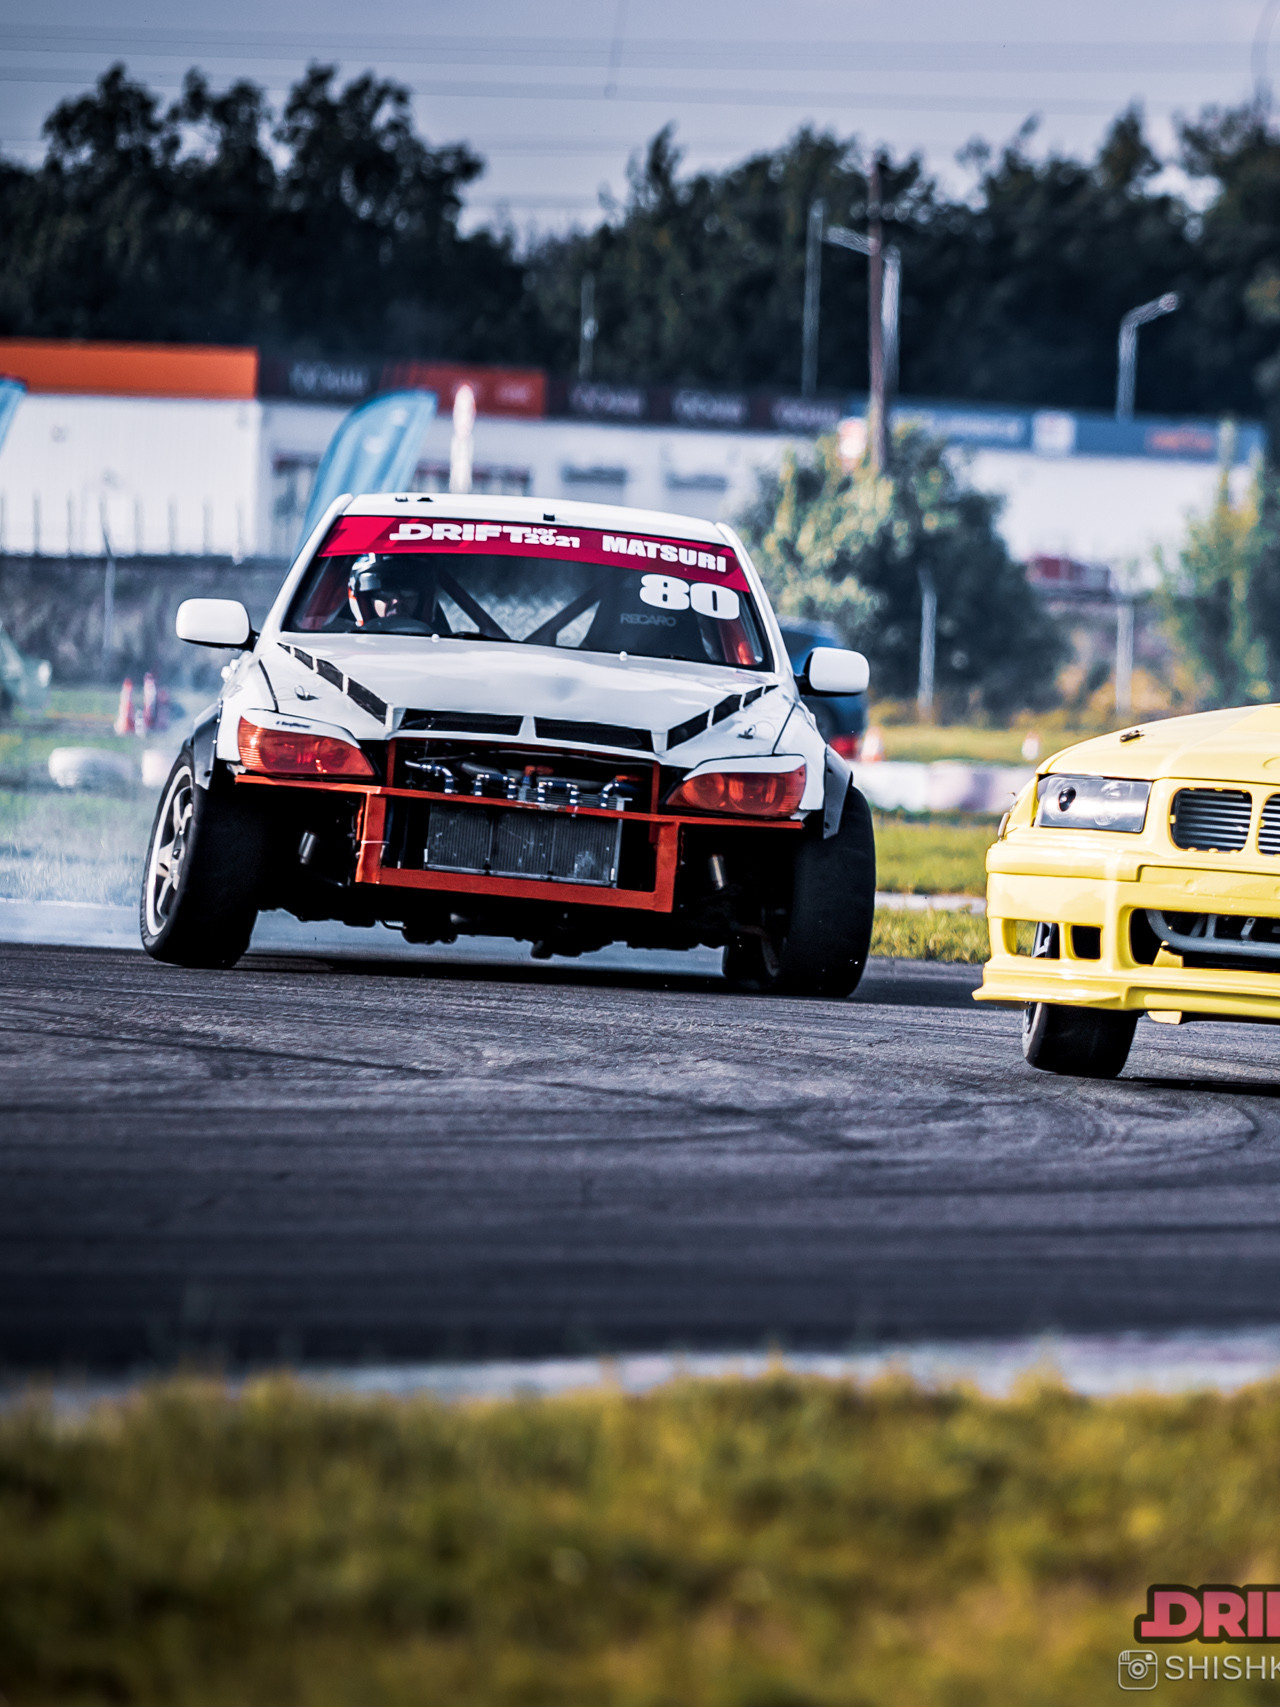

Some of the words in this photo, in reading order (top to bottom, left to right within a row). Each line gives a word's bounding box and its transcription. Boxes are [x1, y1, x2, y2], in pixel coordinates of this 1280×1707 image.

[389, 523, 532, 544] DRIFT
[524, 533, 580, 549] 2021
[602, 535, 726, 573] MATSURI
[620, 613, 677, 627] RECARO
[639, 574, 740, 620] 80
